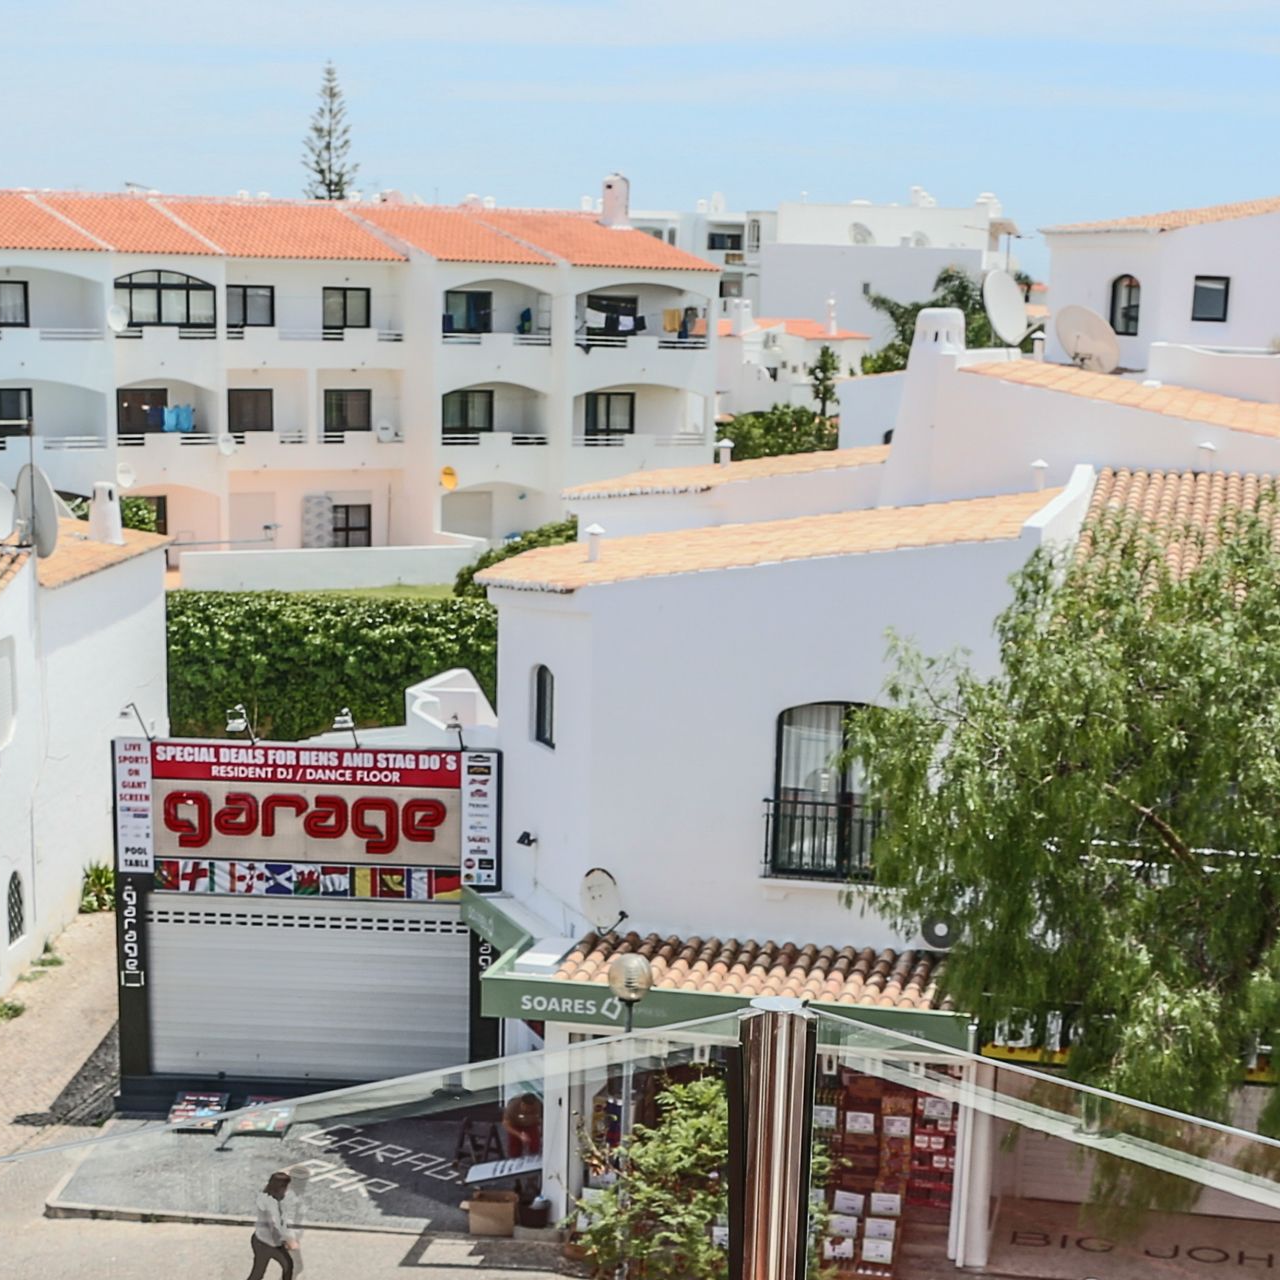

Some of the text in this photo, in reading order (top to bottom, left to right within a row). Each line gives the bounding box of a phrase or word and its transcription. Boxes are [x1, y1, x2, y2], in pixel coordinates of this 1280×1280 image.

[124, 743, 141, 751] LIVE
[118, 756, 148, 764] SPORTS
[156, 745, 217, 762] SPECIAL
[220, 747, 265, 764] DEALS
[268, 750, 297, 765] FOR
[300, 750, 339, 766] HENS
[343, 752, 374, 768] AND
[377, 753, 415, 769] STAG
[211, 766, 273, 778] RESIDENT
[277, 767, 293, 779] DJ
[306, 769, 352, 781] DANCE
[357, 770, 400, 783] FLOOR
[121, 781, 147, 789] GIANT
[119, 793, 150, 801] SCREEN
[164, 790, 447, 855] garage
[125, 847, 147, 855] POOL
[124, 859, 148, 867] TABLE
[521, 995, 596, 1015] SOARES
[1010, 1231, 1114, 1252] BIG
